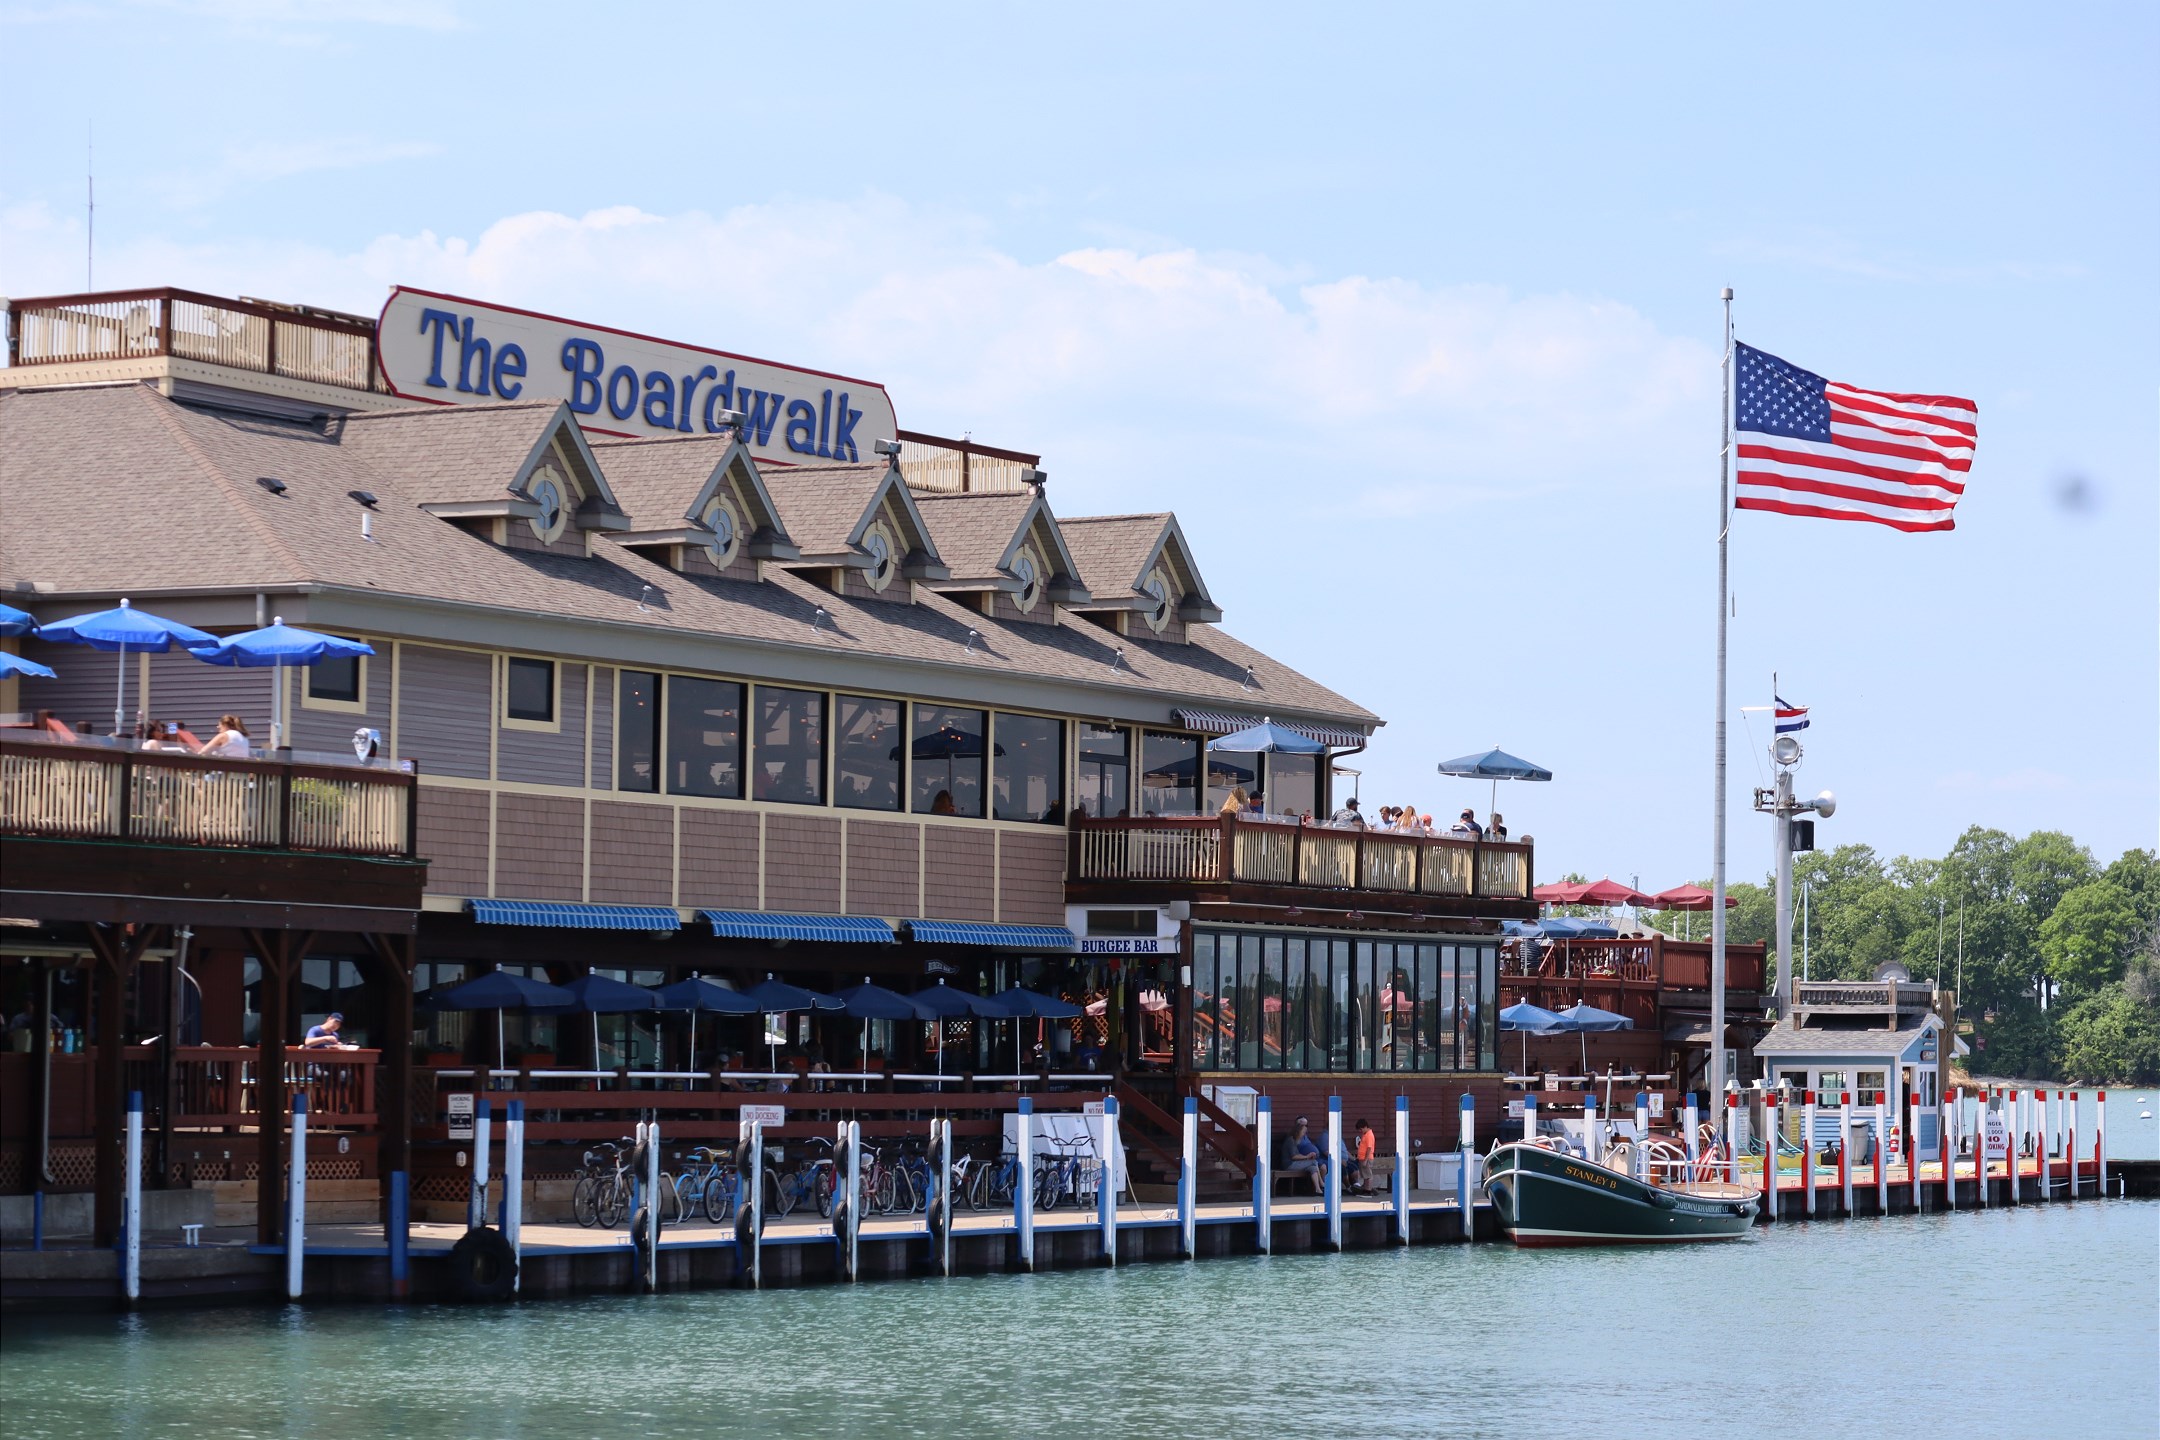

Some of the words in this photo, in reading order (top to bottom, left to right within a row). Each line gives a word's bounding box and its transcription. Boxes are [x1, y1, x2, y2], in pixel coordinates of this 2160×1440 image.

[419, 308, 528, 400] The
[561, 338, 863, 463] Boardwalk
[1081, 940, 1131, 953] BURGEE
[1133, 940, 1159, 953] BAR
[745, 1111, 754, 1120] NO
[755, 1112, 779, 1120] DOCKING
[1565, 1165, 1609, 1187] STANLEY
[1609, 1180, 1617, 1189] B
